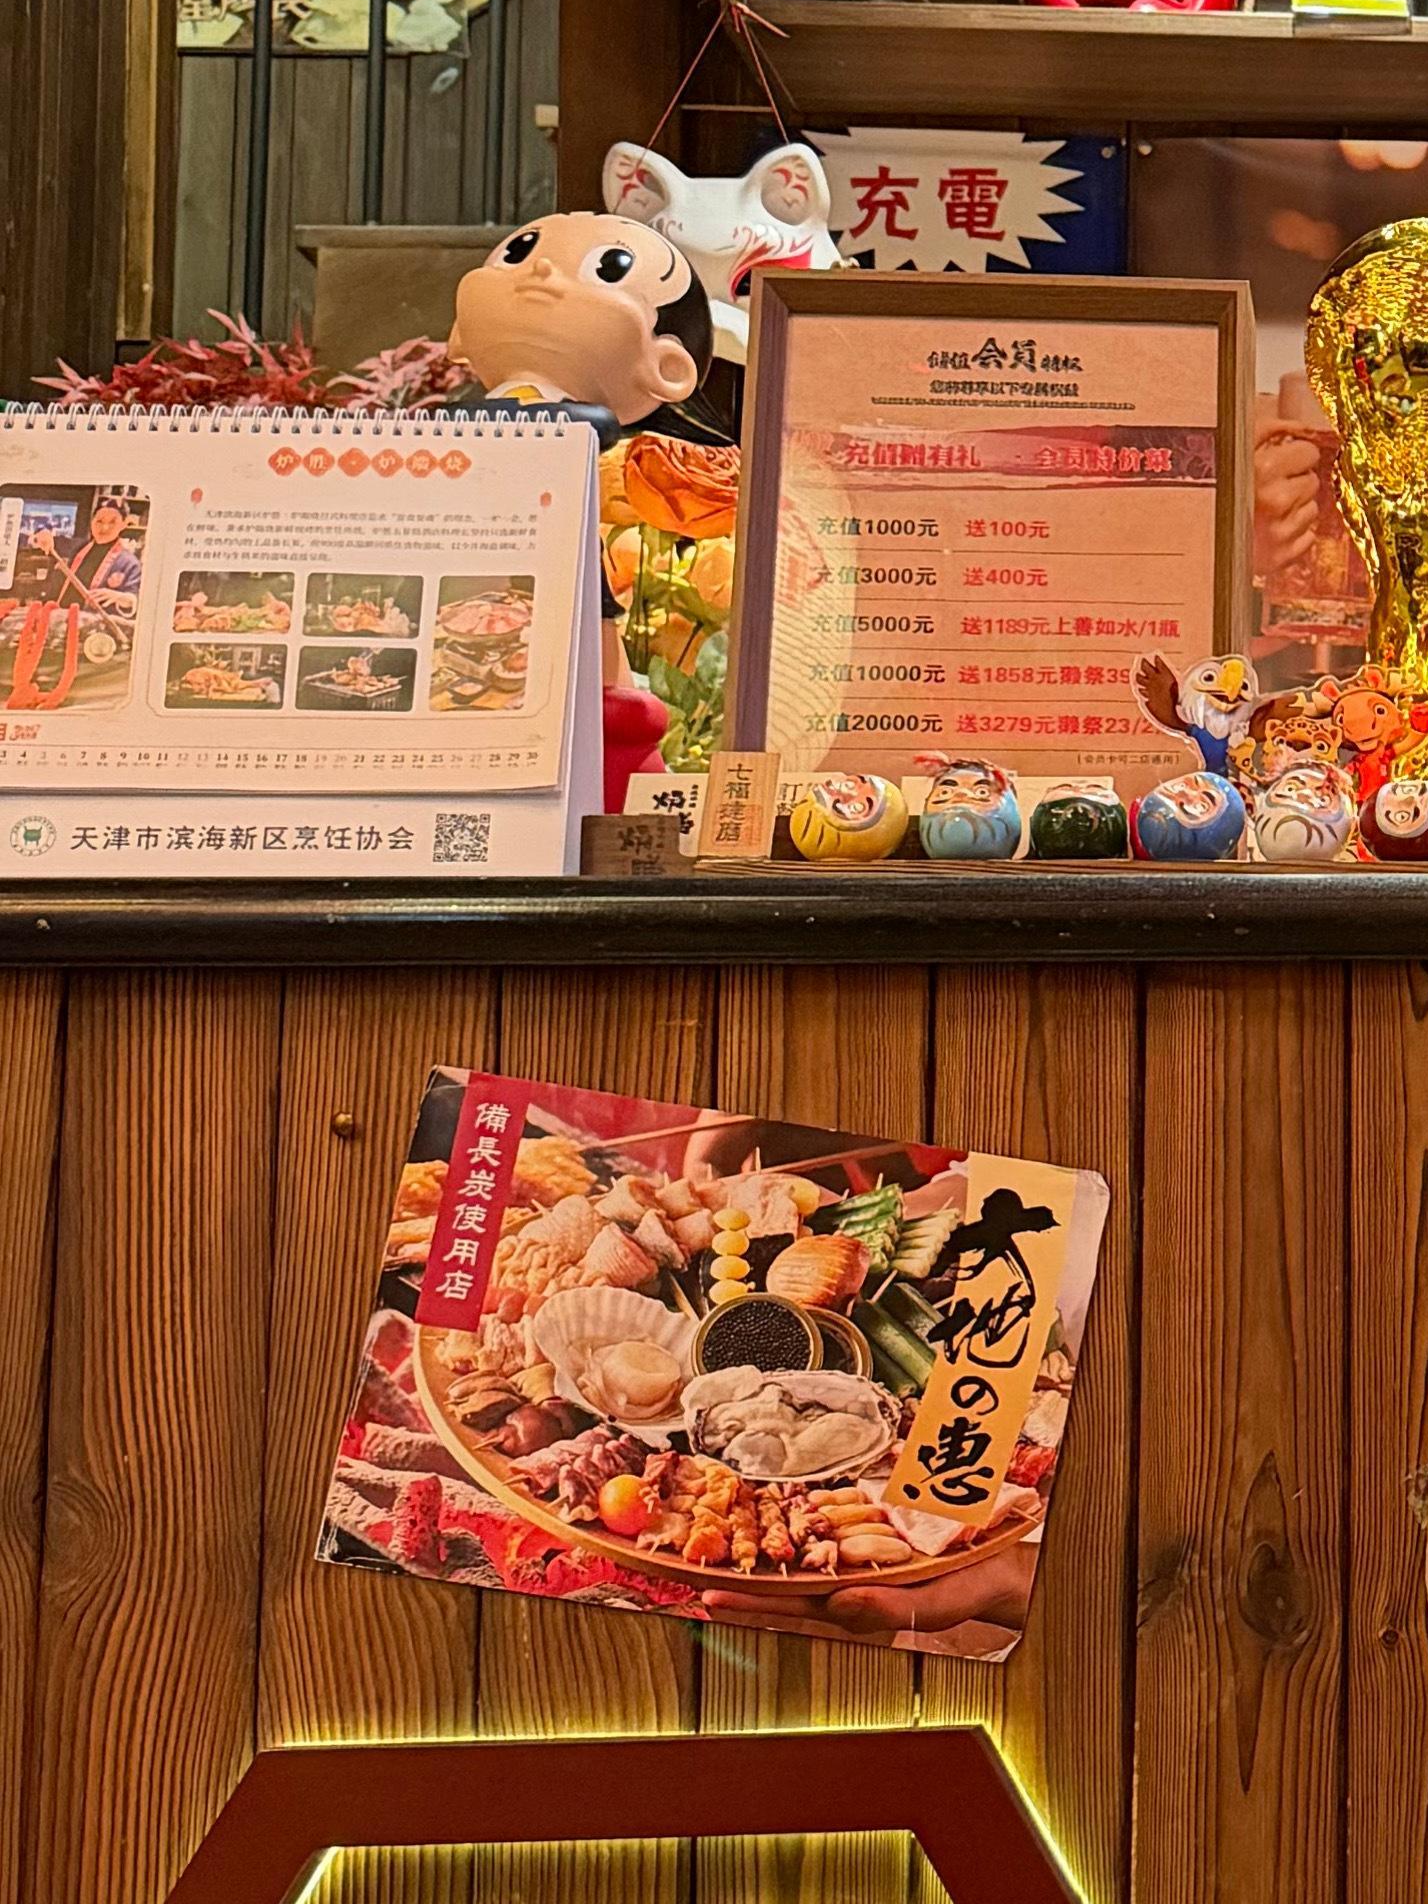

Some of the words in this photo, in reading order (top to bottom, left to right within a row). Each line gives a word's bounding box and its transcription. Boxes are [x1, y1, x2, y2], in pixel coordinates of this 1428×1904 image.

[848, 164, 1010, 242] 充電
[816, 515, 940, 538] 充值1000元
[965, 518, 1050, 539] 送100元
[814, 566, 938, 587] 充值3000元
[962, 566, 1048, 587] 送400元
[810, 615, 935, 635] 充值5000元
[807, 664, 946, 684] 充值10000元
[804, 713, 944, 734] 充值20000元
[70, 824, 416, 852] 天津市滨海新区烹饪协会
[434, 1101, 512, 1301] 備長炭使用店
